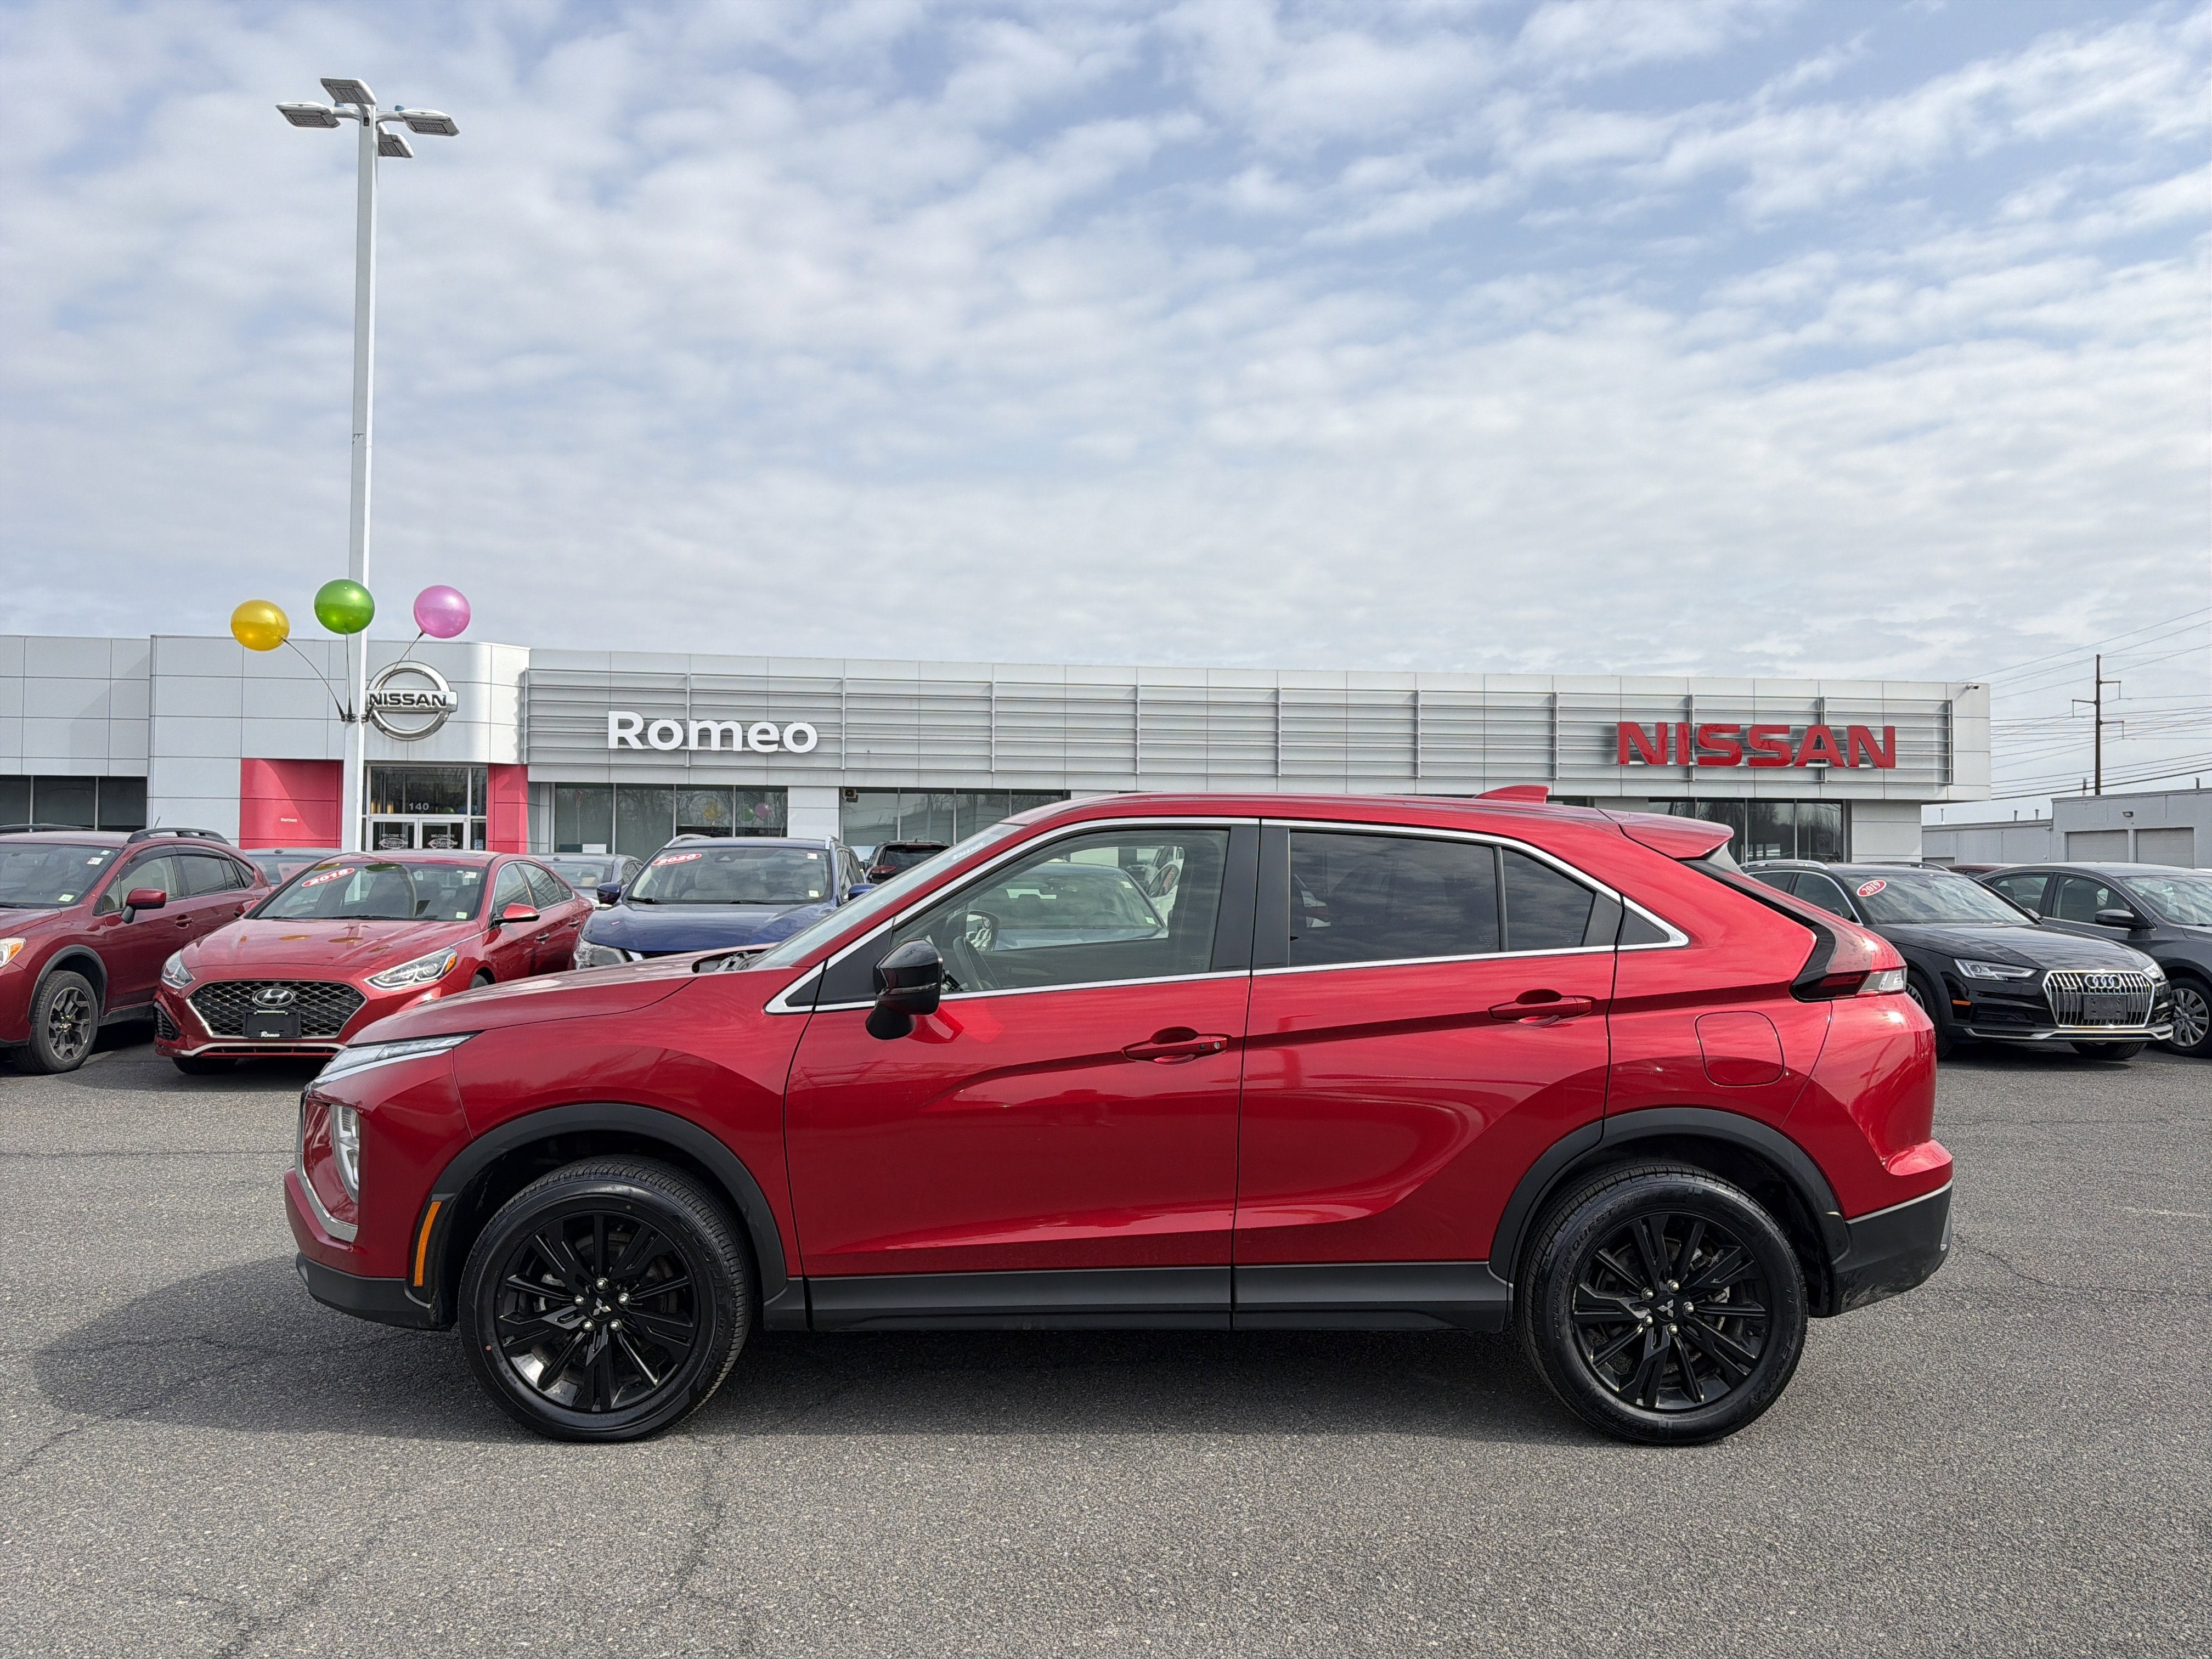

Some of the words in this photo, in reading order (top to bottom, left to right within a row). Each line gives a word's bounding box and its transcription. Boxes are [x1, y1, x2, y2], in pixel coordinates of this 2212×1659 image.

[369, 693, 447, 707] NISSAN
[608, 710, 818, 753] Romeo
[1617, 721, 1895, 768] NISSAN
[409, 803, 429, 811] 140
[658, 854, 696, 864] 2020
[1861, 881, 1881, 895] 2019
[1572, 1209, 1613, 1251] QUEST
